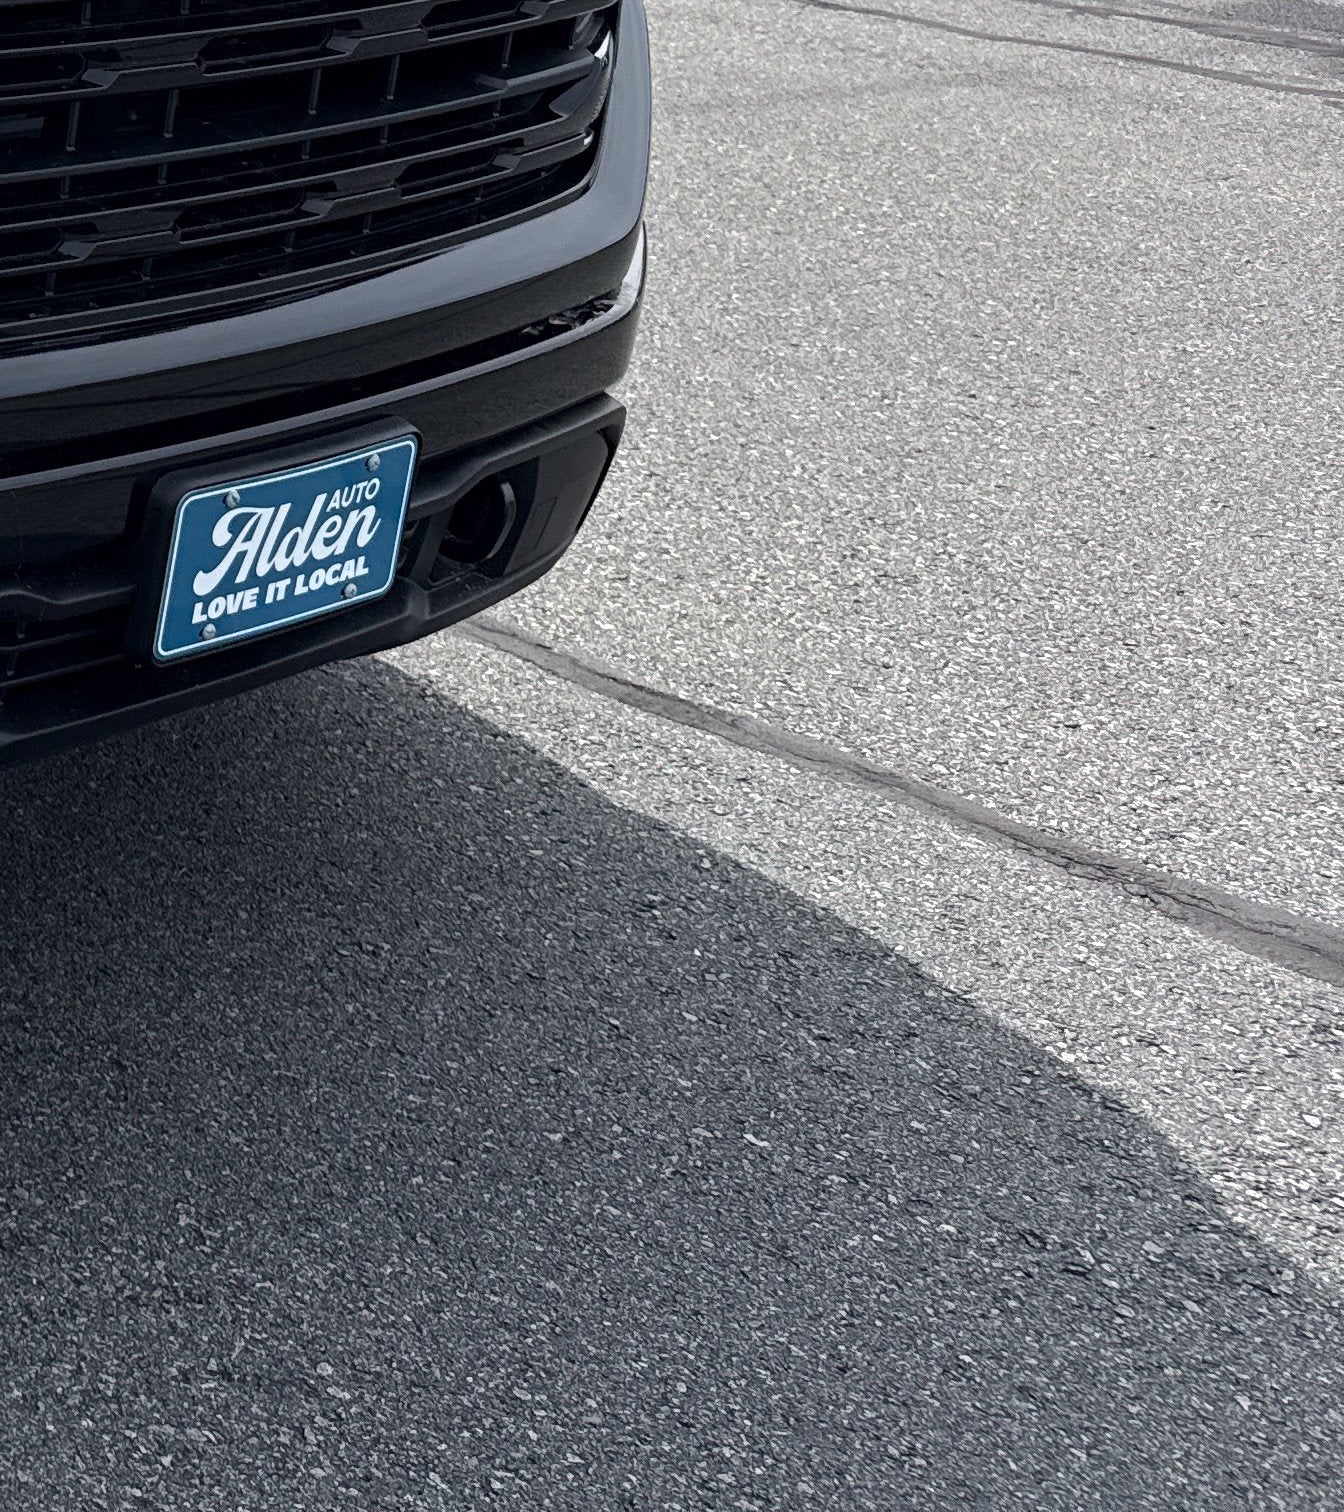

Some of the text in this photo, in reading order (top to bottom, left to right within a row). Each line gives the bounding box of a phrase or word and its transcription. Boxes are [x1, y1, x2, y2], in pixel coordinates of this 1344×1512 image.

[326, 477, 380, 512] AUTO
[193, 493, 381, 596] Alden
[192, 555, 369, 624] LOVE IT LOCAL
